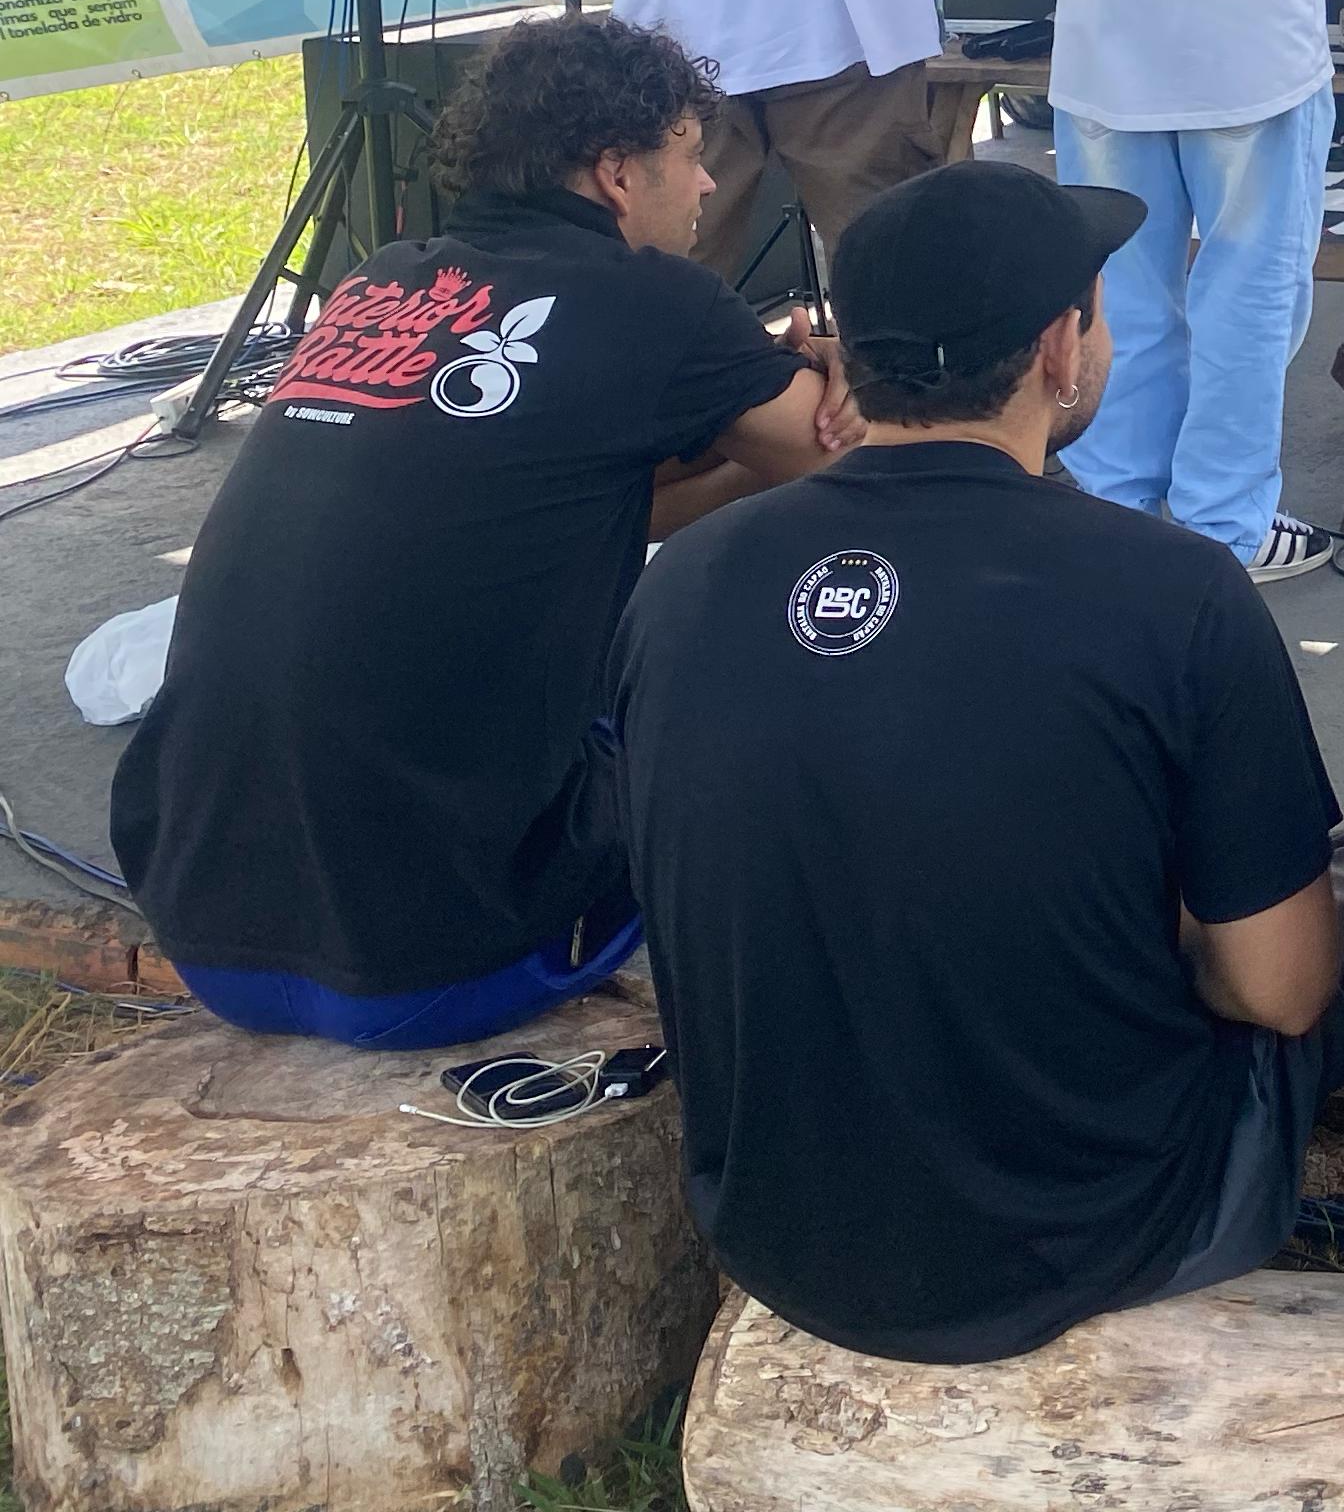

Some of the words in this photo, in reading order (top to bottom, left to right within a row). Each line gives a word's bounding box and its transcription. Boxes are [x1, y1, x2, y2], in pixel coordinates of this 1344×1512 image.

[8, 19, 79, 39] tonelada
[82, 14, 101, 28] de
[103, 10, 143, 25] vidro
[48, 6, 77, 21] que
[319, 275, 495, 335] Interior
[280, 326, 437, 387] Battle
[284, 405, 298, 418] by
